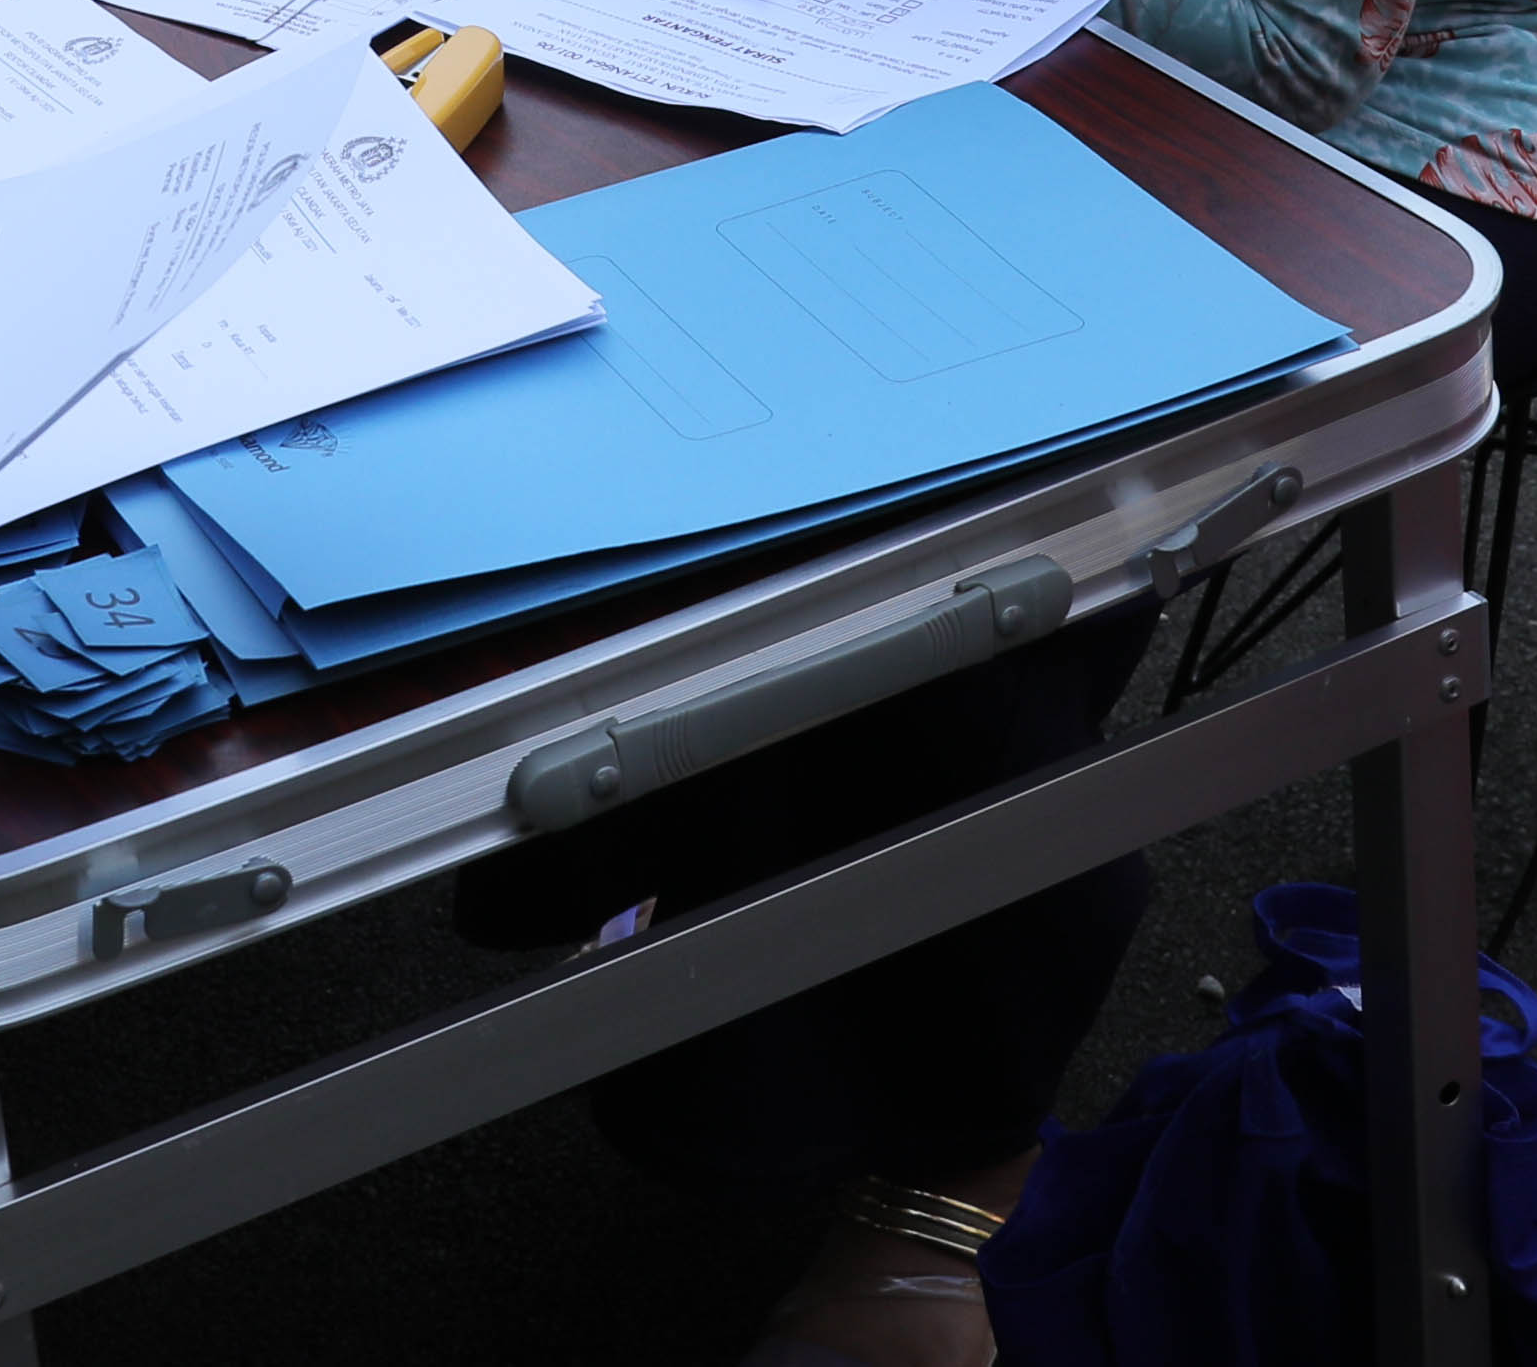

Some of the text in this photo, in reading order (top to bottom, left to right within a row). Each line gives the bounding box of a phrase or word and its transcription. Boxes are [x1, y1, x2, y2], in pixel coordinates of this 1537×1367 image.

[641, 12, 732, 49] PENGANTAR
[535, 39, 709, 100] RUKUN TETANGGA 001/06
[734, 43, 785, 65] SURAT
[337, 173, 363, 201] METRO
[355, 198, 375, 217] JAYA
[861, 189, 904, 220] SUBJECT
[343, 215, 373, 246] SELATAN
[811, 204, 837, 225] DATE
[85, 586, 155, 629] 34
